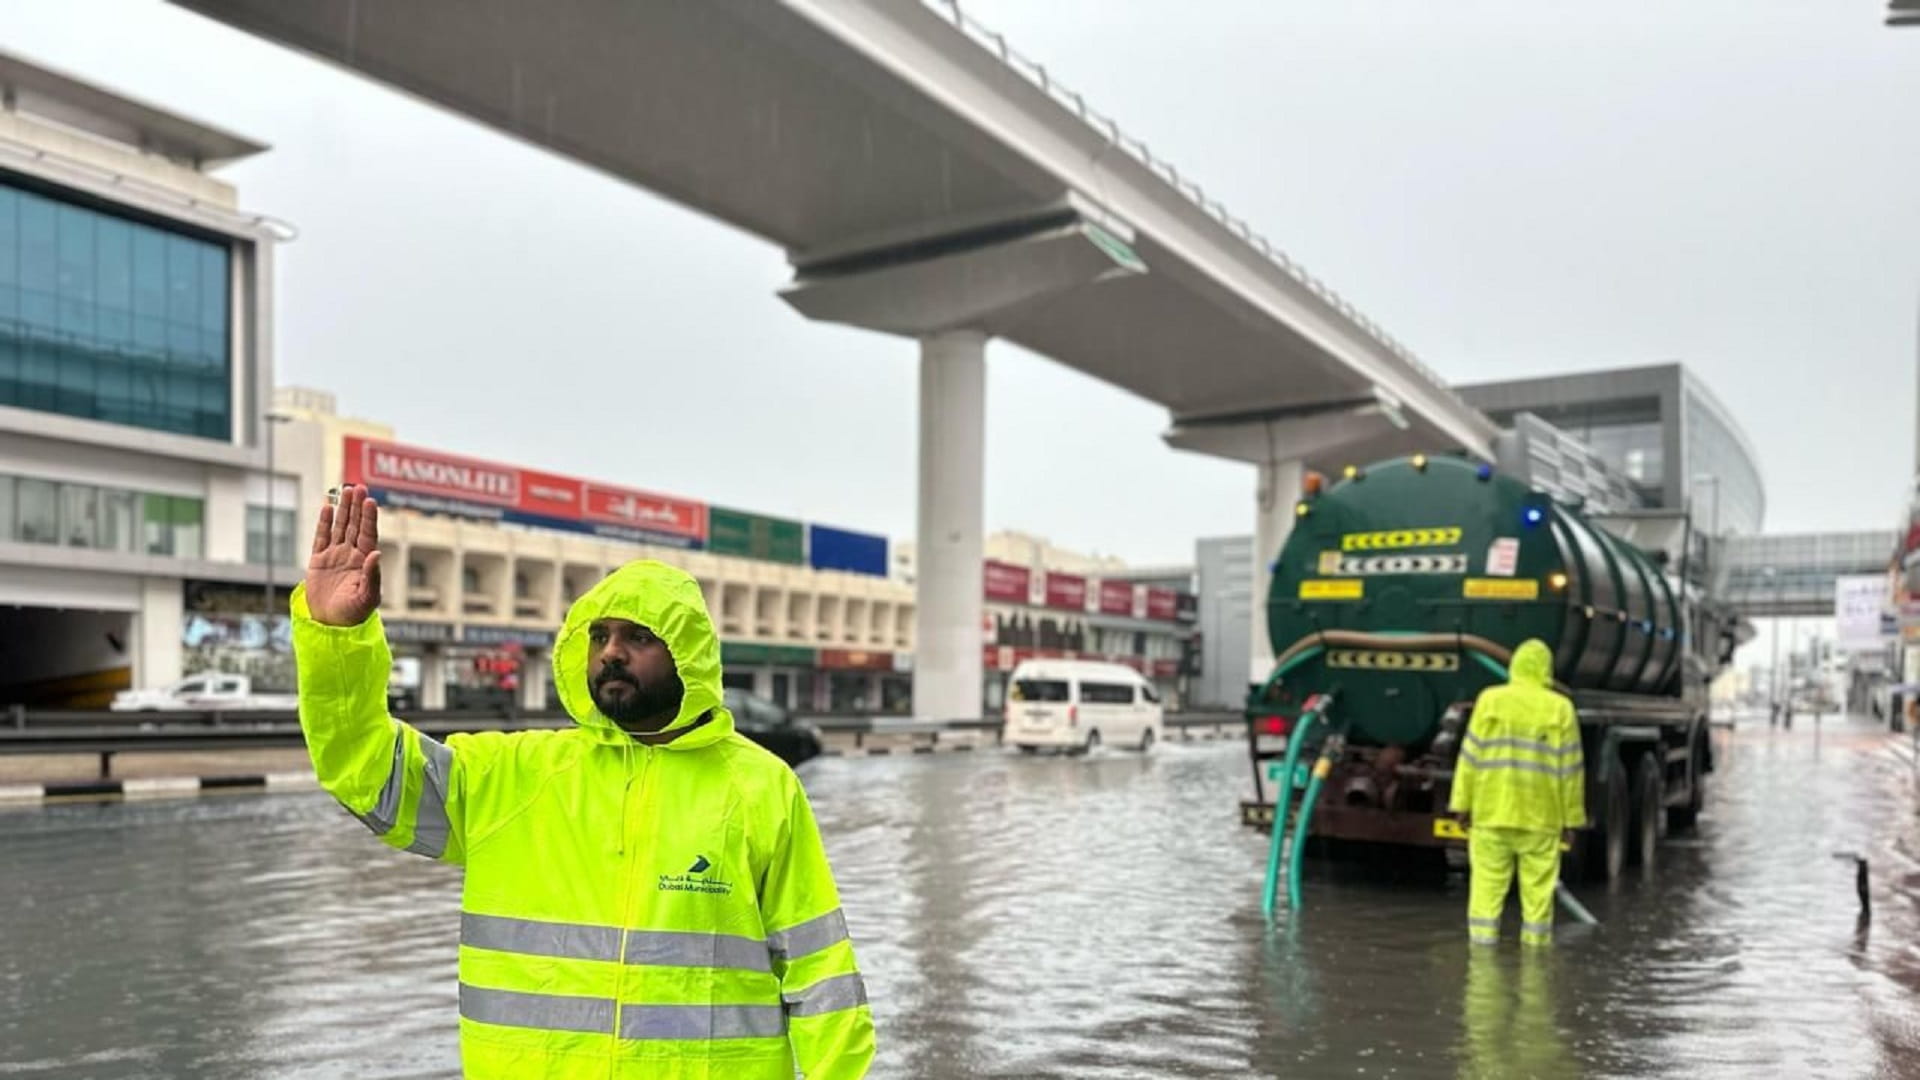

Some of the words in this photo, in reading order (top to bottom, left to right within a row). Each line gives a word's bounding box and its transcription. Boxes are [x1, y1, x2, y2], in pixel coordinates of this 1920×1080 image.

[374, 452, 509, 493] MASONLITE
[658, 882, 683, 891] Dubai
[684, 883, 731, 896] Municipality
